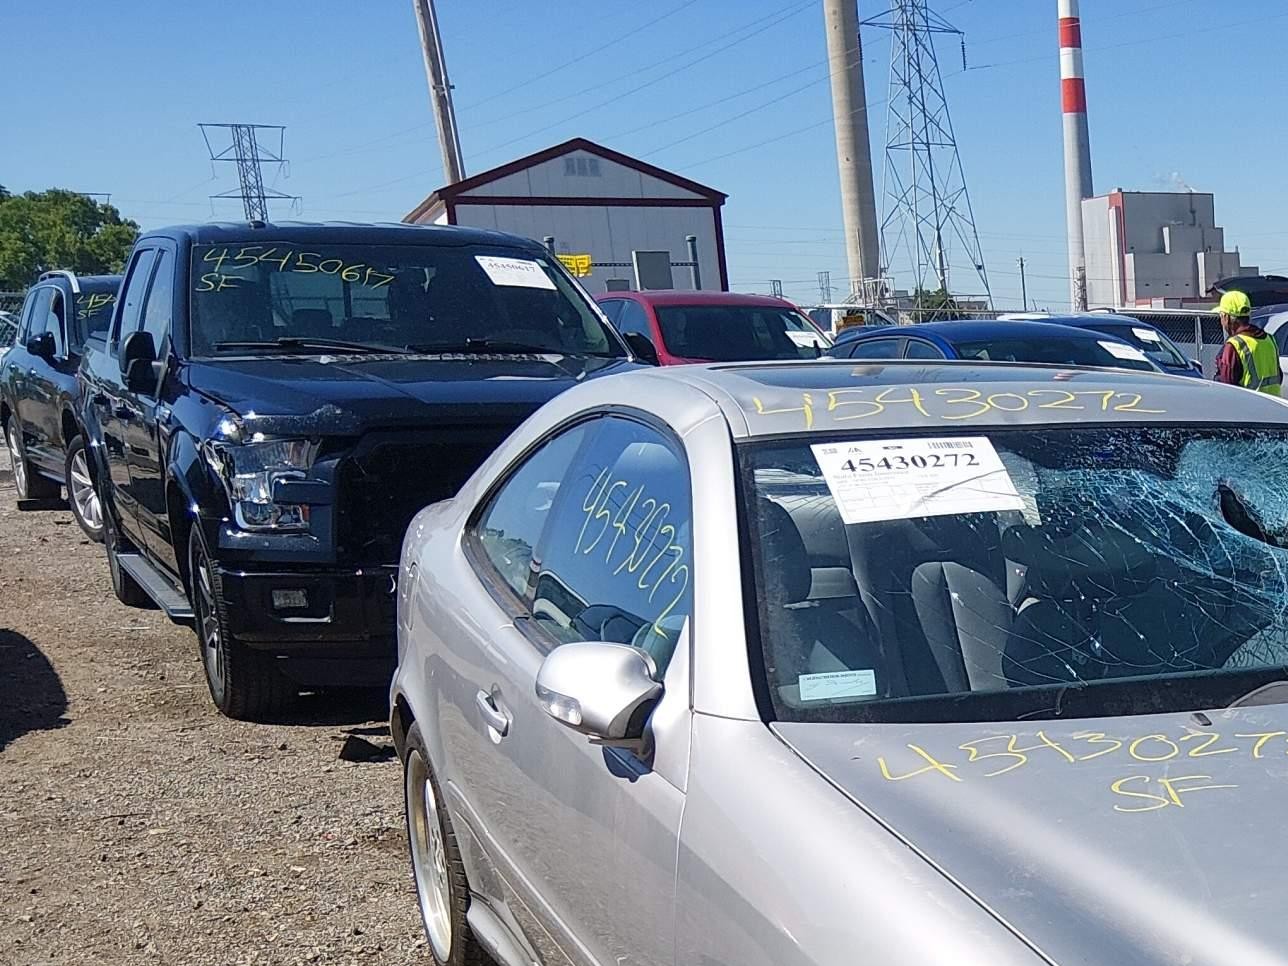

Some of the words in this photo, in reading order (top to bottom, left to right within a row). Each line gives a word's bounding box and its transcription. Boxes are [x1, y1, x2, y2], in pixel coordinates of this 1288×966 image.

[195, 272, 246, 292] SF
[752, 387, 1167, 429] 45430272
[841, 453, 980, 473] 45430272
[573, 466, 689, 640] 45430272
[1110, 775, 1239, 812] SF
